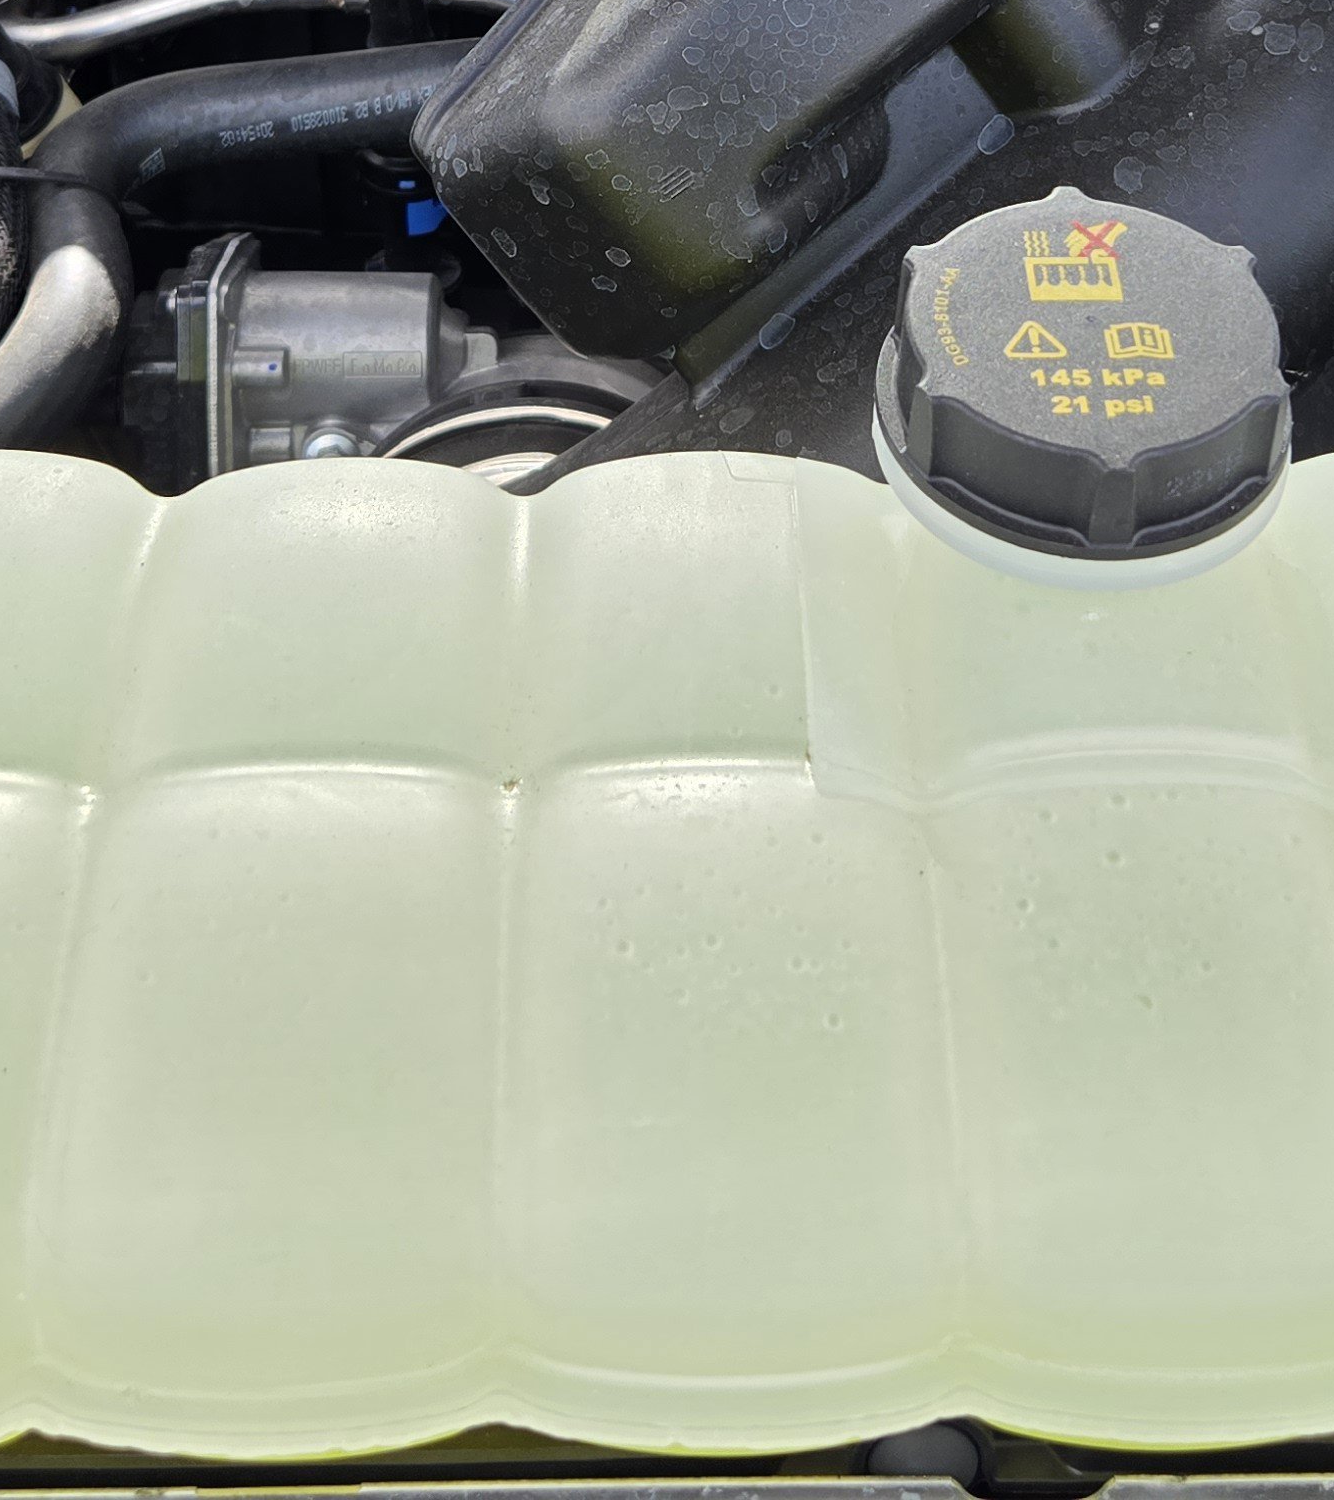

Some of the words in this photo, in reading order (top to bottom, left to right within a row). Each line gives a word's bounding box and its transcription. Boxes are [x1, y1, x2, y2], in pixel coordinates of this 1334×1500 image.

[355, 100, 369, 119] B2
[220, 120, 275, 148] 20:54:02
[1030, 368, 1092, 386] 145
[1101, 368, 1165, 386] kPa
[1051, 395, 1091, 414] 21
[1104, 395, 1154, 418] psi
